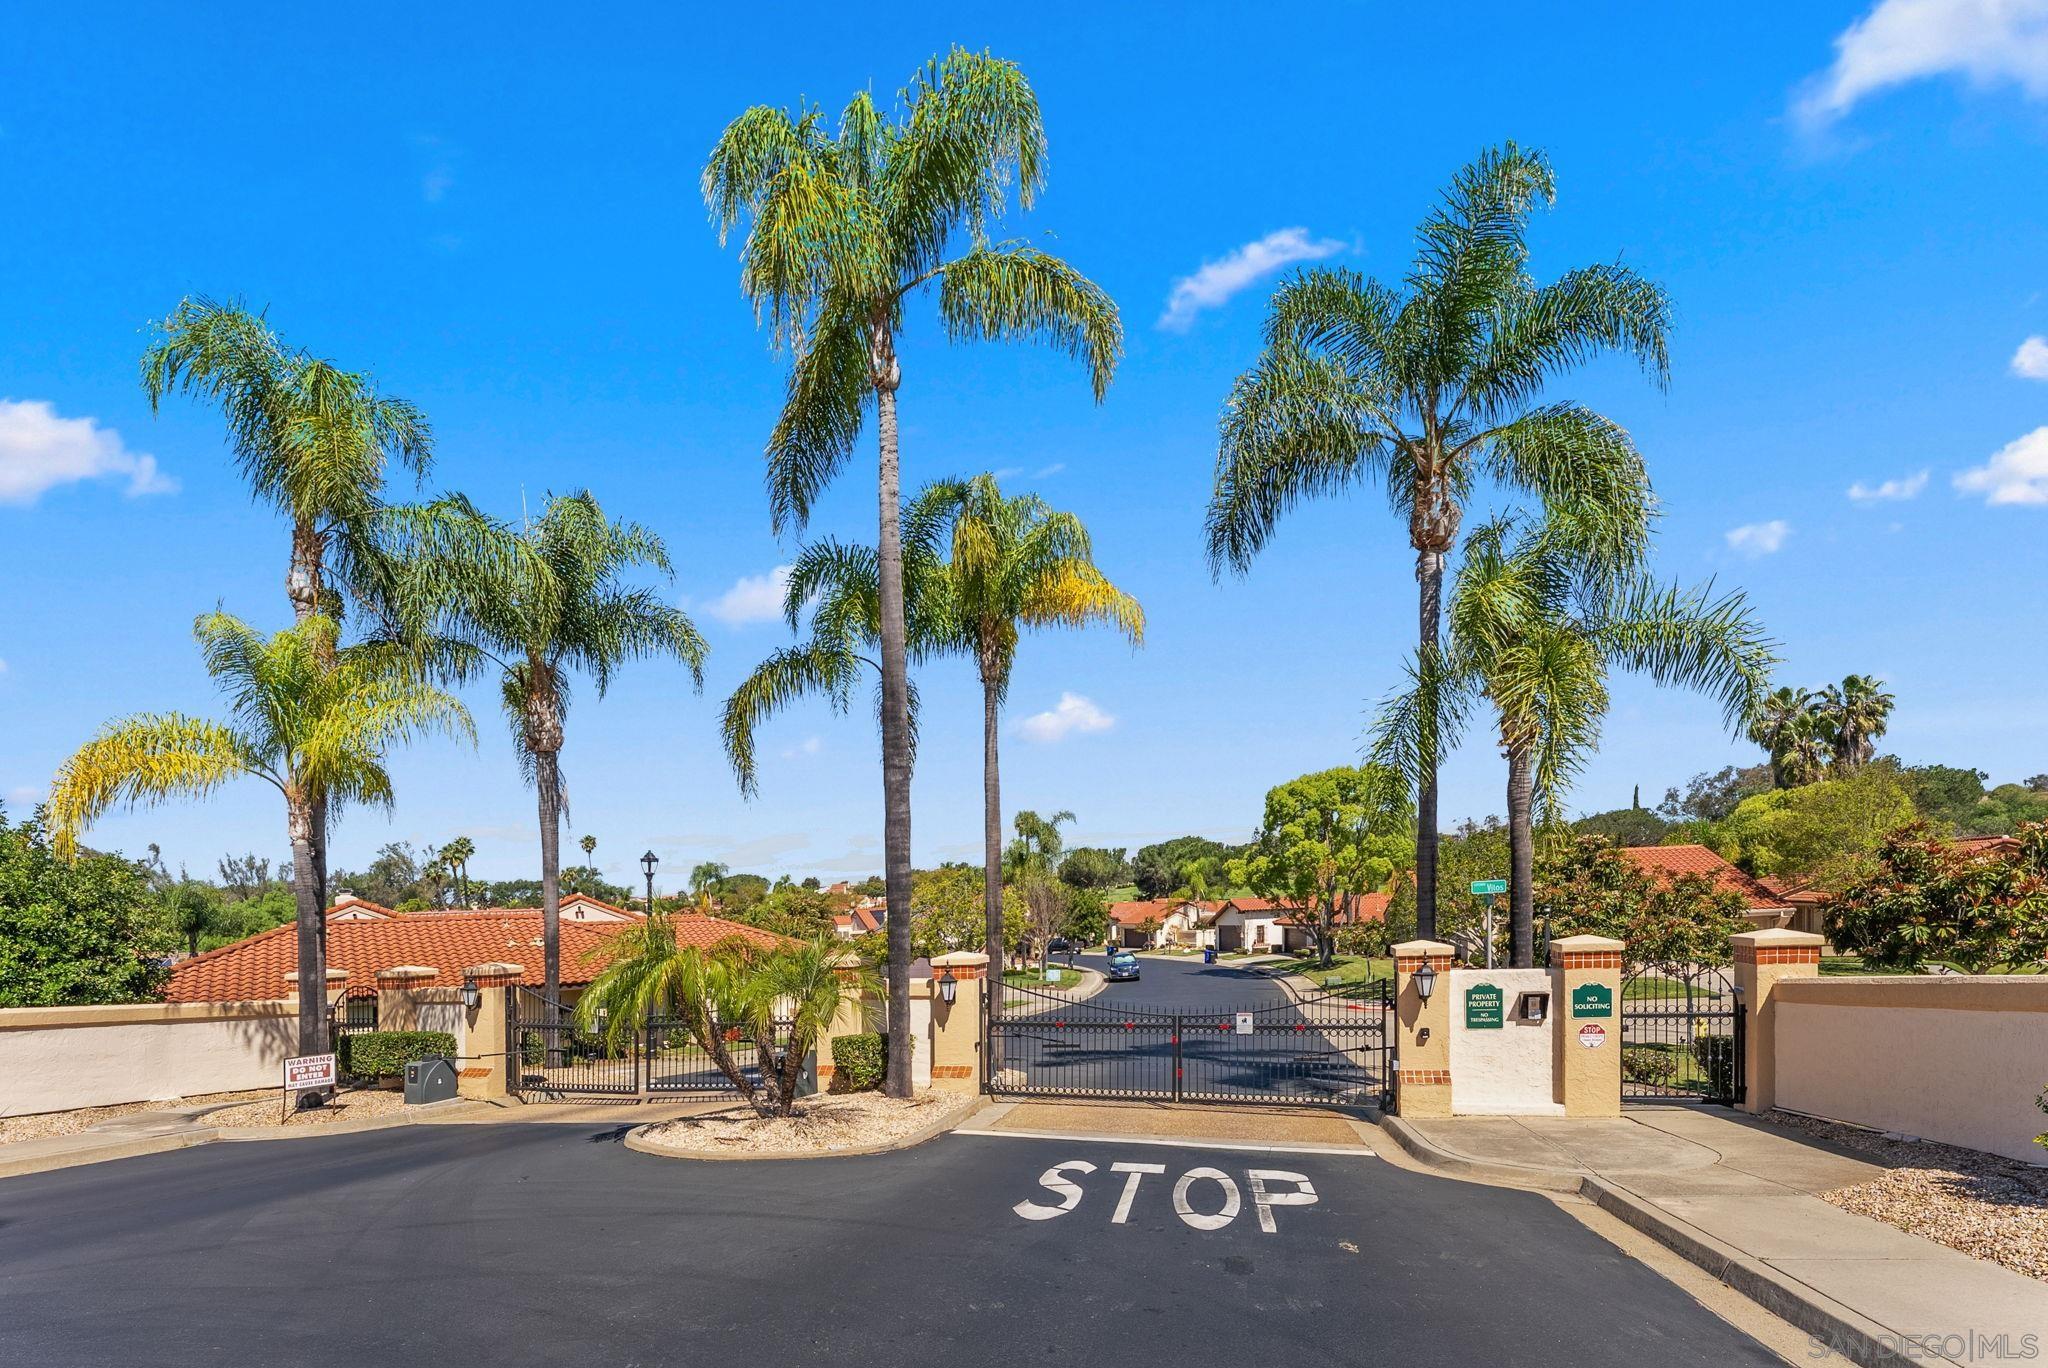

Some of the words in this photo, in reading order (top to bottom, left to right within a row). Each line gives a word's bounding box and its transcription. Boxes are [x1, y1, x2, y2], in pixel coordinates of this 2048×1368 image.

[1468, 1000, 1501, 1008] PROPERTY
[1583, 1026, 1601, 1034] STOP
[287, 1056, 333, 1066] WARNING
[296, 1072, 324, 1080] ENTER
[1012, 1160, 1319, 1233] STOP
